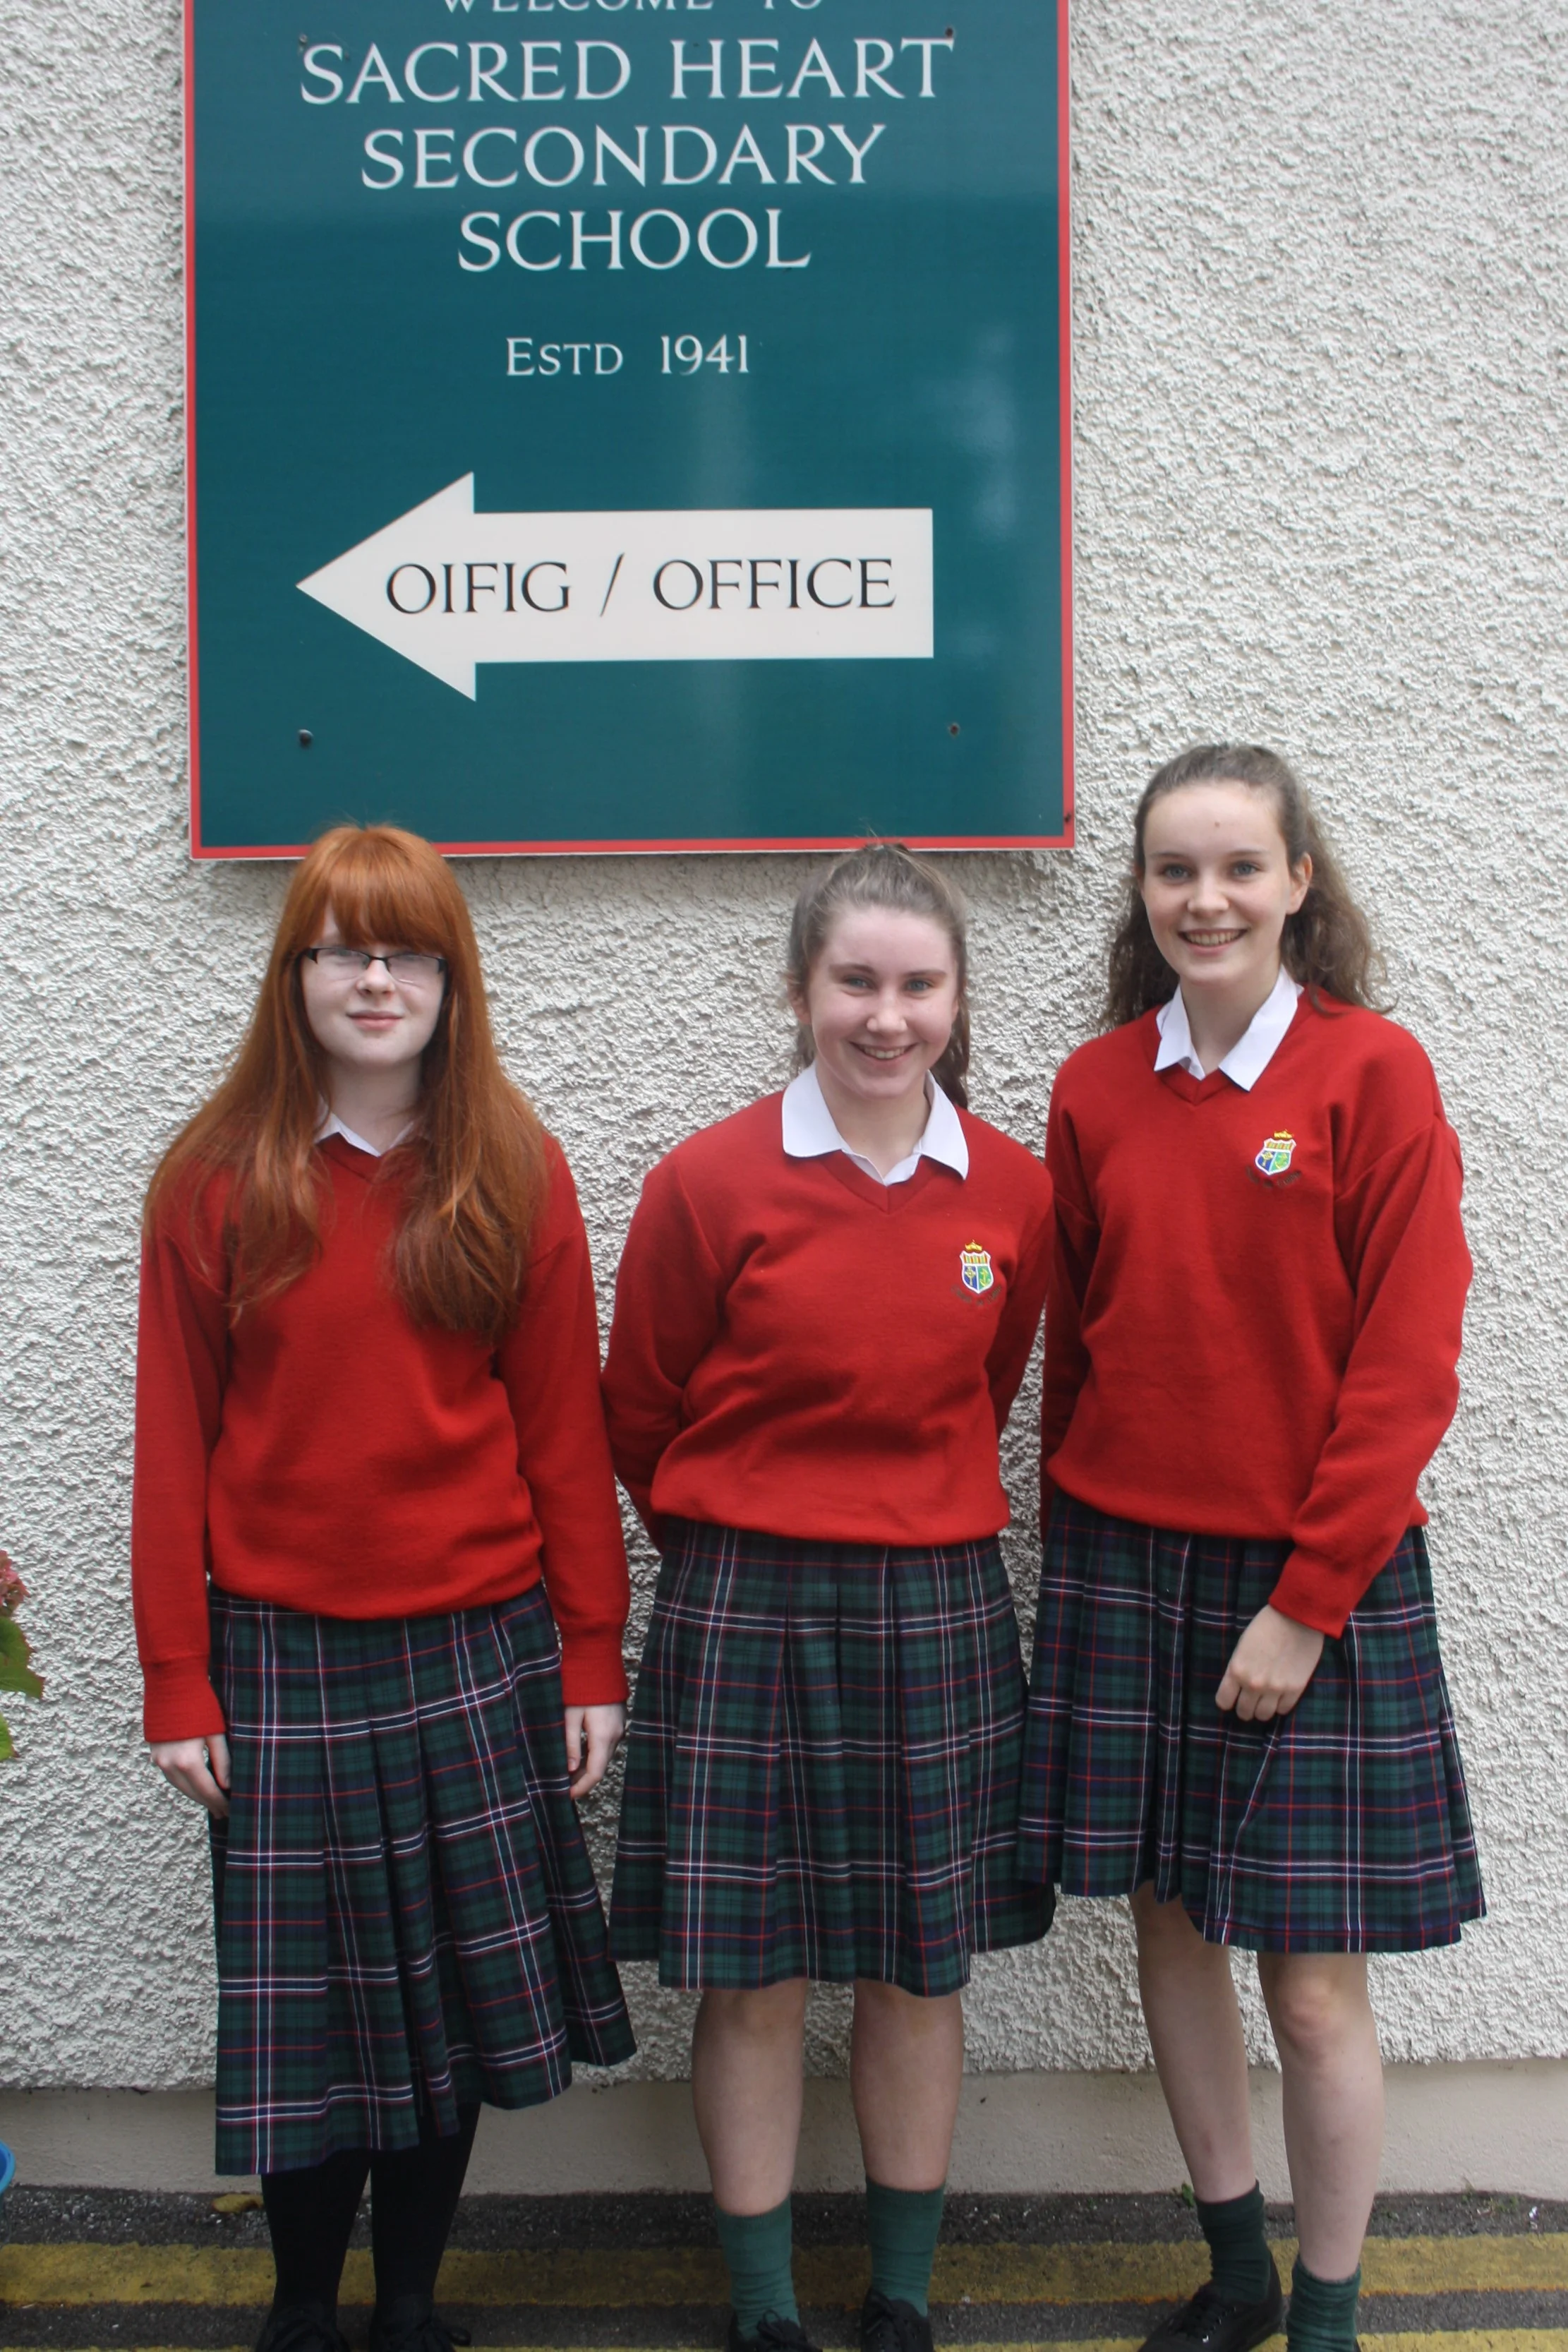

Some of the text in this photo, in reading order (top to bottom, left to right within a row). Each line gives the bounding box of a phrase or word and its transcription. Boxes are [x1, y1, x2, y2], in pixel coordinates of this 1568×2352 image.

[301, 37, 955, 105] SACRED HEART
[361, 124, 886, 191] SECONDARY
[458, 208, 812, 272] SCHOOL
[661, 335, 750, 375] 1941
[386, 553, 896, 618] OIFIG / OFFICE
